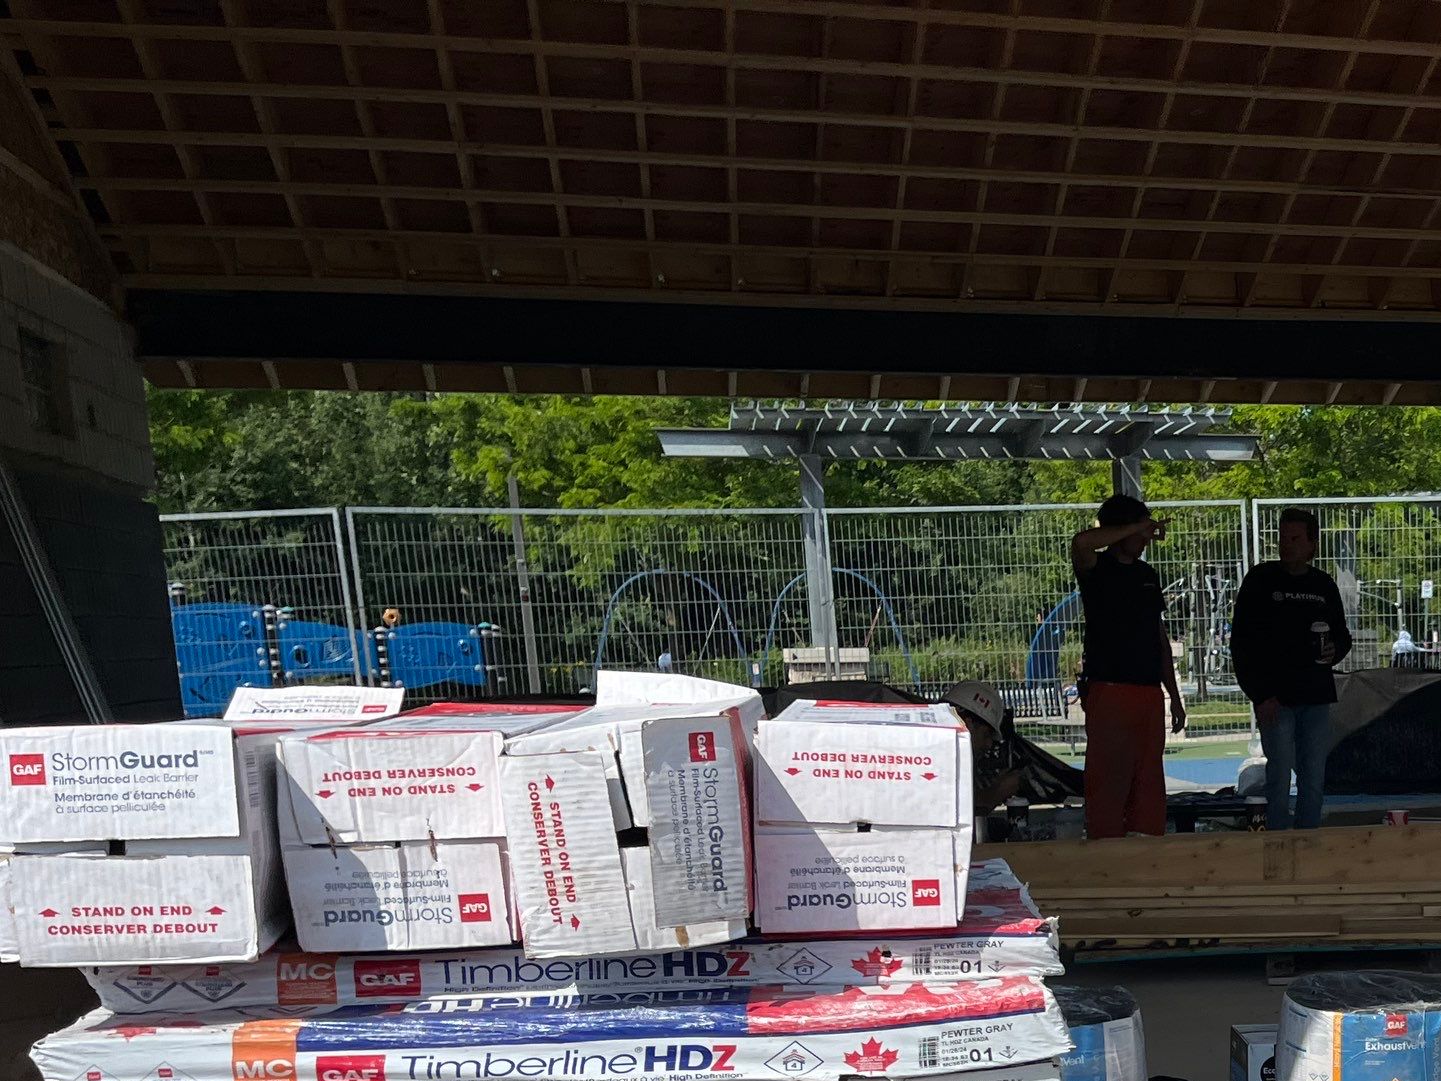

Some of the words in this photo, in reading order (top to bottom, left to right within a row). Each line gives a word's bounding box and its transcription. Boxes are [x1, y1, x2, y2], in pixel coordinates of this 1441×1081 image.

[696, 734, 708, 760] GAF
[52, 750, 199, 771] StormGuard
[792, 751, 846, 762] DEBOUT
[851, 754, 932, 765] CONSERVER
[13, 764, 42, 776] GAF
[322, 770, 382, 782] DEBOUT
[388, 766, 476, 780] CONSERVER
[813, 768, 839, 778] END
[845, 770, 862, 779] ON
[868, 770, 911, 781] STAND
[53, 776, 130, 786] Film-Surfaced
[164, 773, 199, 783] Barrier
[348, 787, 376, 797] END
[382, 786, 403, 796] ON
[408, 784, 455, 795] STAND
[54, 793, 119, 803] Membrane
[66, 803, 109, 813] surface
[112, 801, 166, 813] pelliculée
[550, 802, 566, 848] STAND
[703, 768, 728, 892] StormGuard
[527, 782, 551, 866] CONSERVER
[544, 871, 562, 925] DEBOUT
[558, 852, 570, 871] ON
[853, 865, 906, 875] Membrane
[563, 875, 577, 903] END
[914, 888, 938, 898] GAF
[787, 891, 907, 910] StormGuard
[71, 907, 125, 917] STAND
[131, 906, 154, 916] ON
[160, 905, 193, 916] END
[461, 903, 488, 914] GAF
[323, 907, 453, 927] StormGuard
[48, 924, 147, 935] CONSERVER
[153, 923, 218, 934] DEBOUT
[934, 941, 979, 950] PEWTER
[980, 940, 1004, 949] GRAY
[661, 952, 750, 977] HDZ
[960, 959, 983, 974] 01
[279, 961, 334, 981] MC
[360, 973, 414, 987] GAF
[941, 1027, 983, 1039] PEWTER
[985, 1023, 1014, 1034] GRAY
[1387, 1021, 1405, 1029] GAF
[963, 1036, 989, 1044] CANADA
[644, 1045, 737, 1072] HDZ
[969, 1047, 993, 1062] 01
[236, 1059, 293, 1079] MC
[669, 1073, 692, 1081] High
